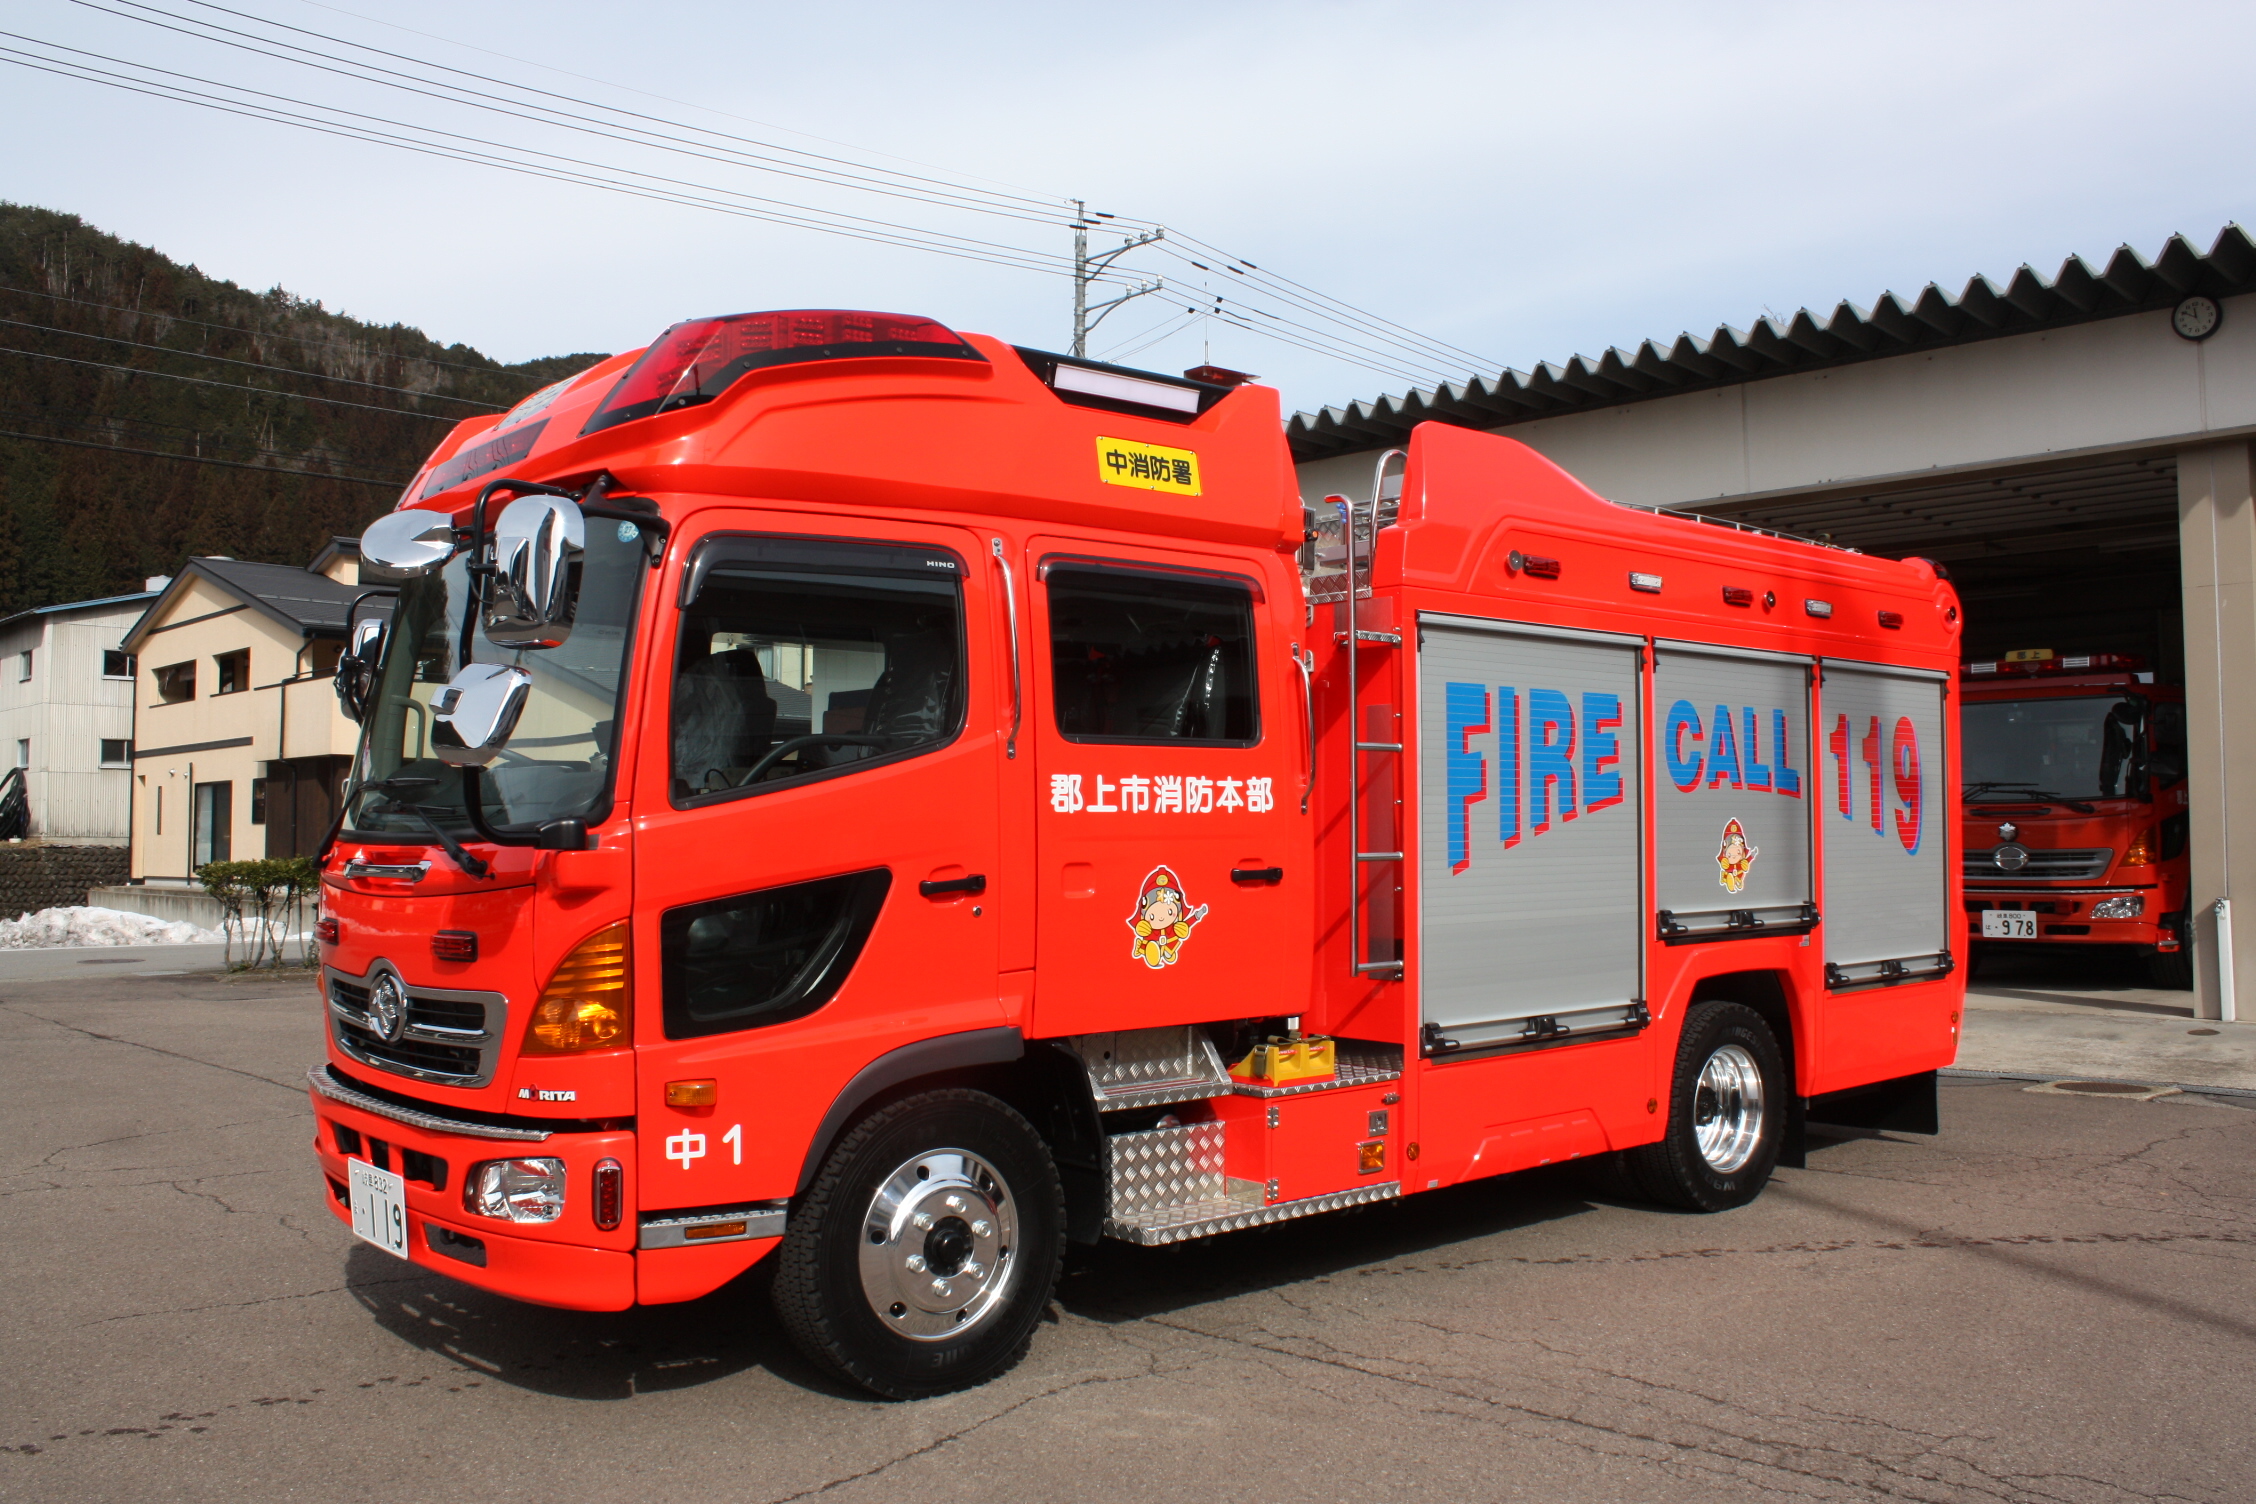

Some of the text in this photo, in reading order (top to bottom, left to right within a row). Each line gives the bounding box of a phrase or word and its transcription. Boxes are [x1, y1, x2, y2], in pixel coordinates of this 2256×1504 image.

[1106, 449, 1192, 485] 中消防署
[926, 560, 955, 569] HINO
[1050, 774, 1274, 814] 郡上市消防本部
[1445, 682, 1923, 877] FIRE CALL 119
[517, 1084, 576, 1102] MORITA
[665, 1123, 742, 1170] 中 1
